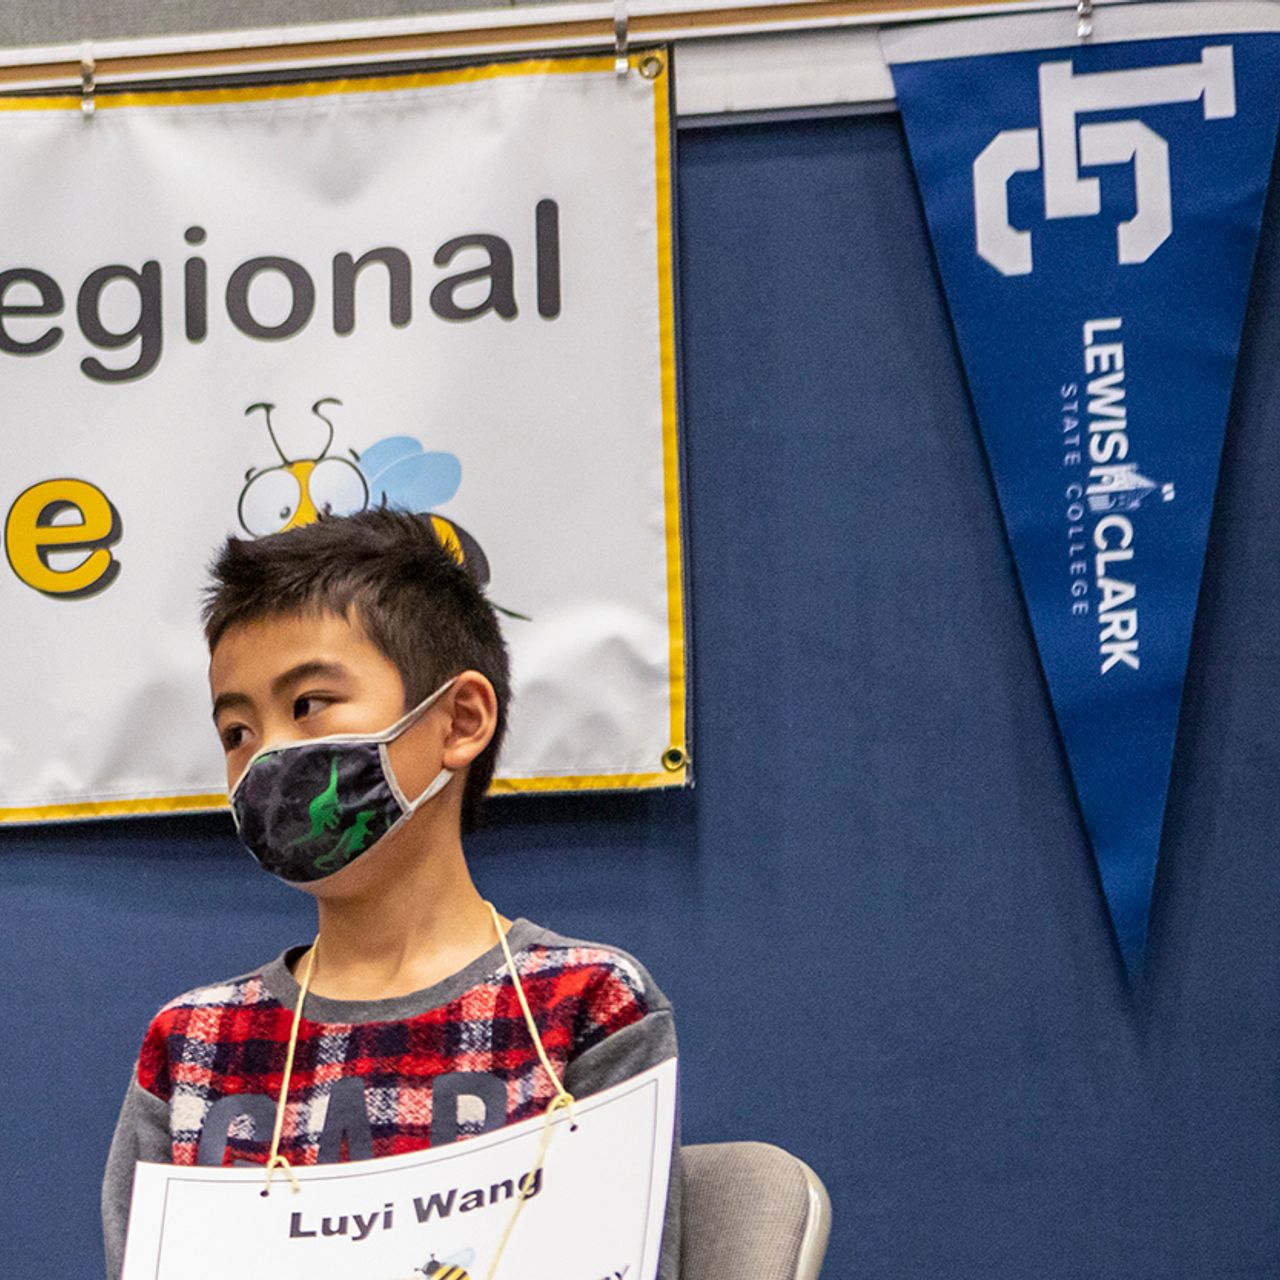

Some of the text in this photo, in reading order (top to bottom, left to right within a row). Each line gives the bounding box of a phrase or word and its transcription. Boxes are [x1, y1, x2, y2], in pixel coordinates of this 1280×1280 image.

[1059, 382, 1089, 617] STATE COLLEGE
[1083, 316, 1141, 675] LEWIS CLARK
[288, 1167, 544, 1242] Luyi Wang
